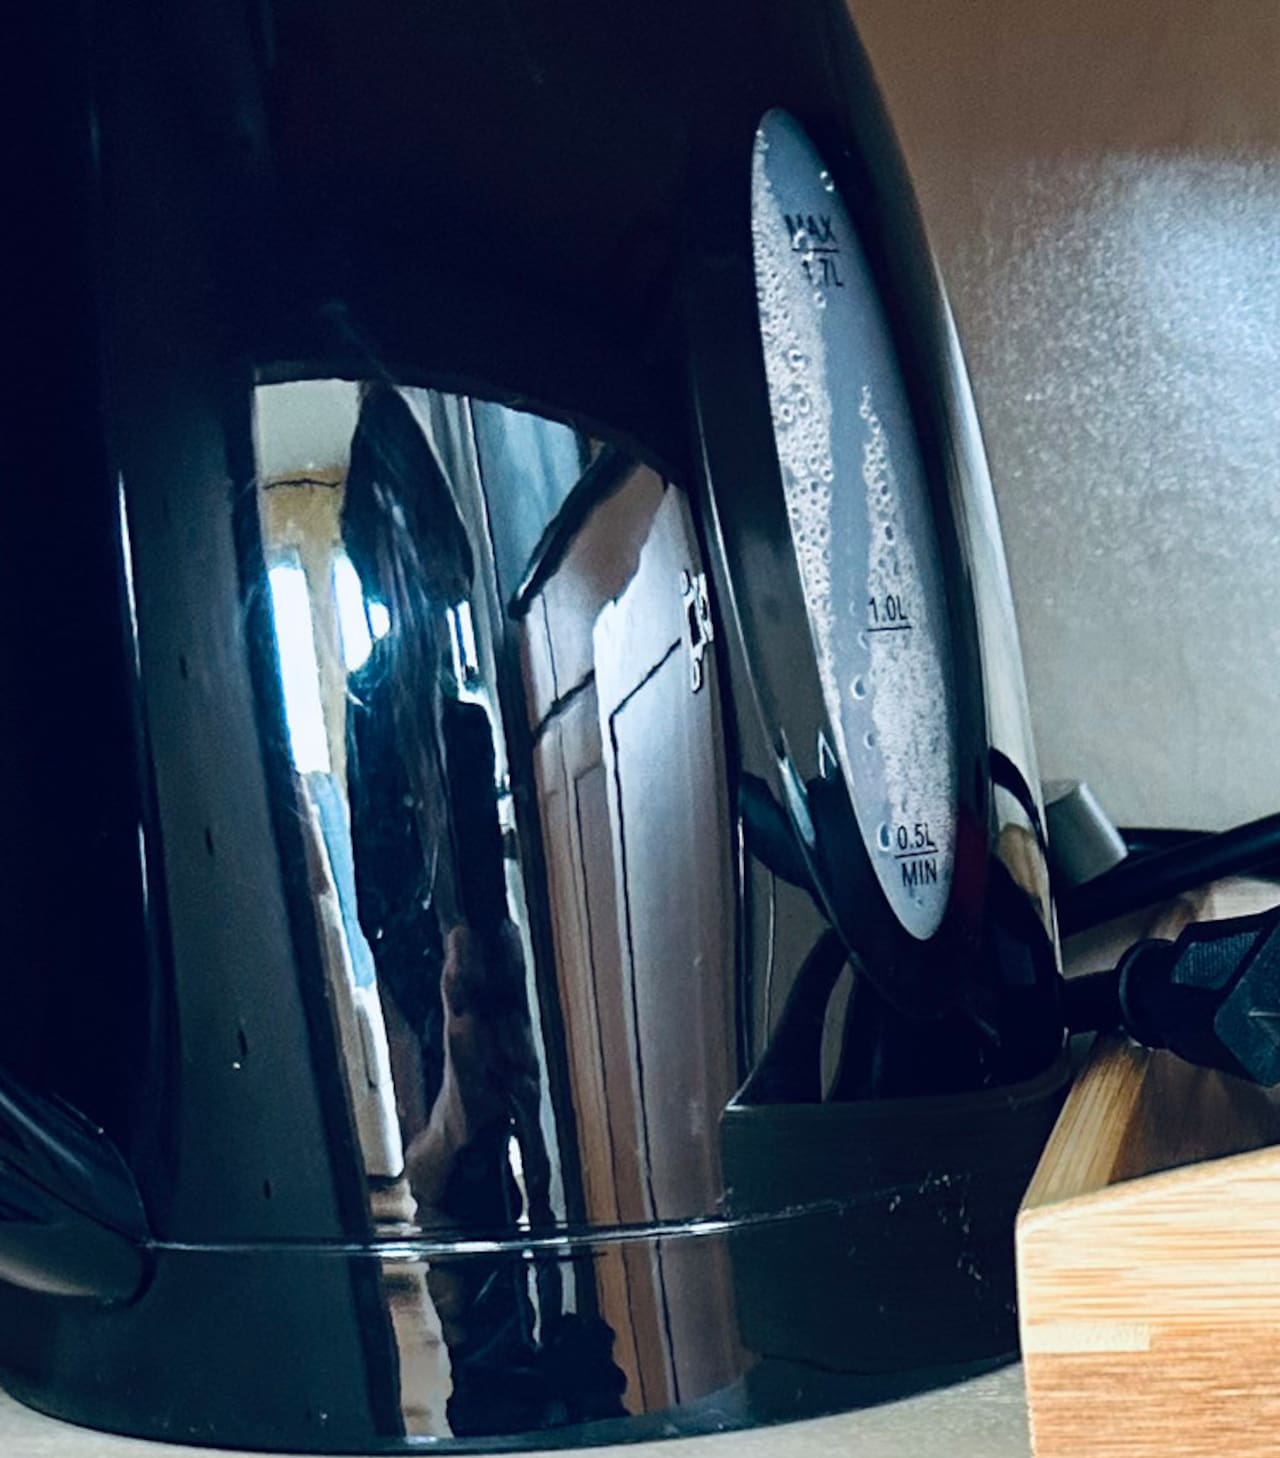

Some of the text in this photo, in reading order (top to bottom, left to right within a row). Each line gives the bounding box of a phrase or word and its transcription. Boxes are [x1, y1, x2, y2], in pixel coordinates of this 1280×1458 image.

[784, 213, 838, 243] MAX
[868, 594, 908, 623] 1.0L
[897, 822, 936, 850] 0.5L
[902, 858, 938, 888] MIN
